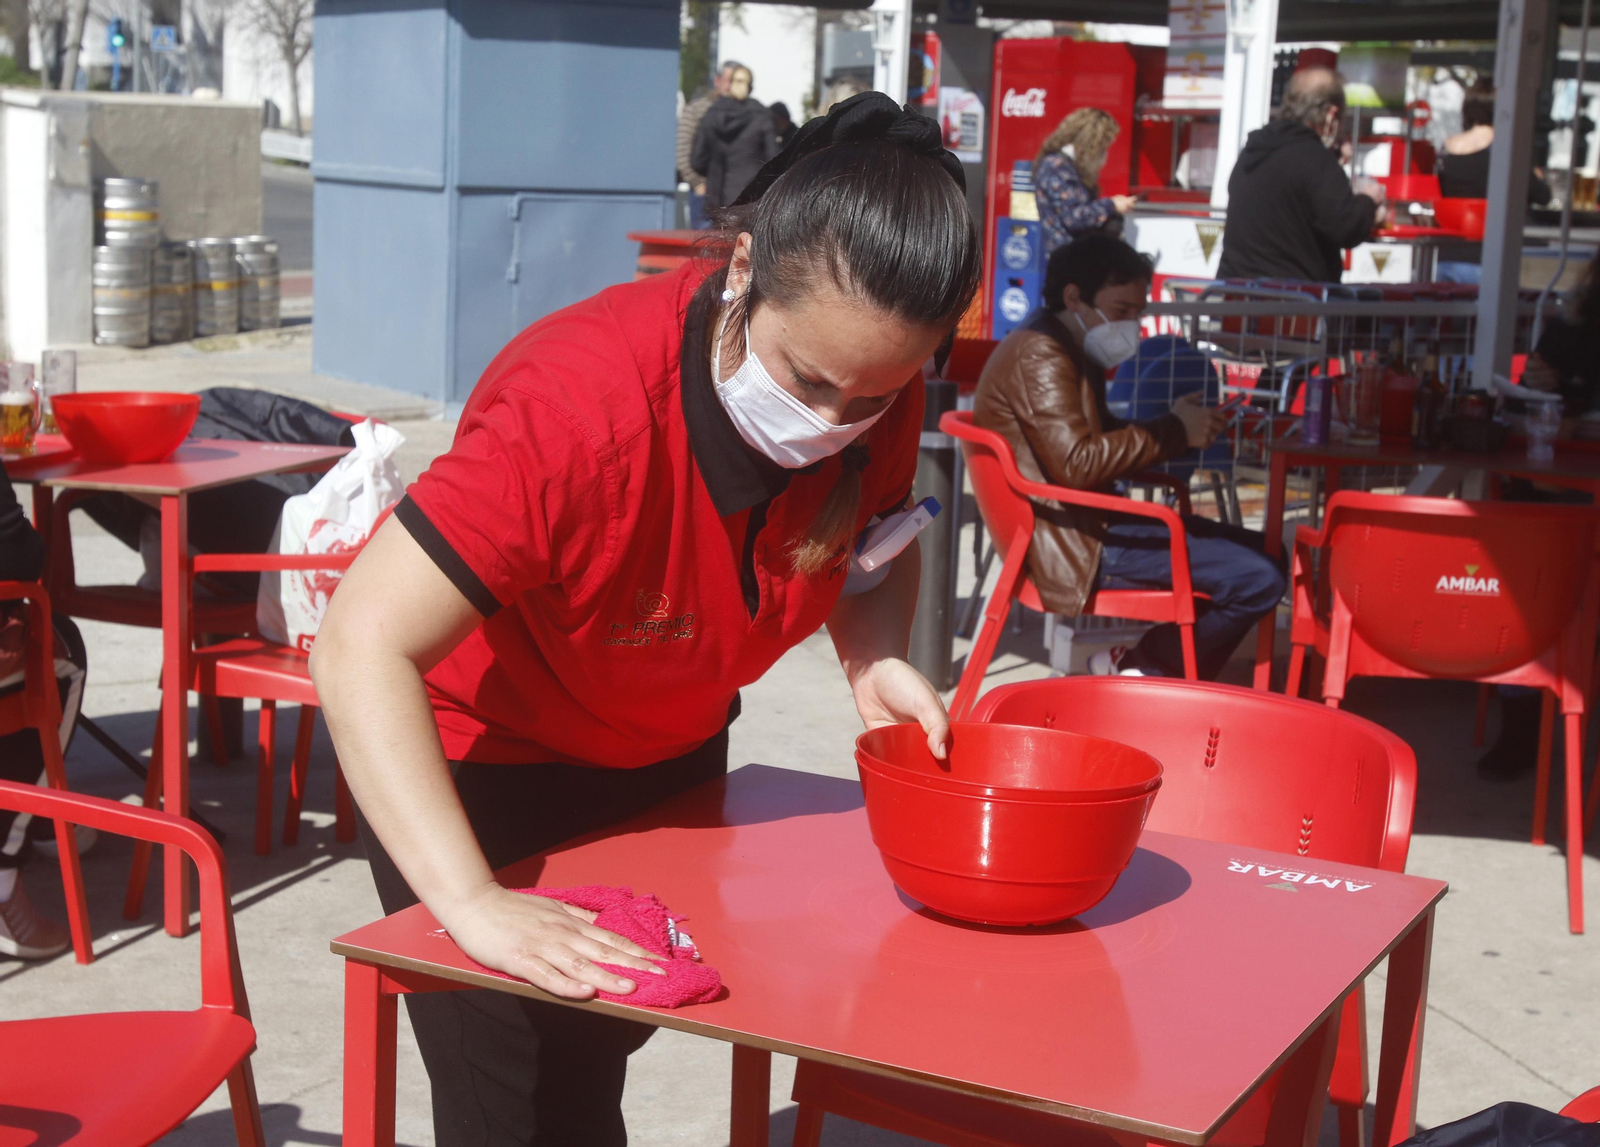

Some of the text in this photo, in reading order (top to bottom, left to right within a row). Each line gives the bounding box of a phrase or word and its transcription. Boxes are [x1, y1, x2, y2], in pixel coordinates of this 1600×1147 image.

[1436, 575, 1499, 593] AMBAR
[633, 614, 694, 635] PREMIO
[1227, 861, 1372, 892] AMBAR
